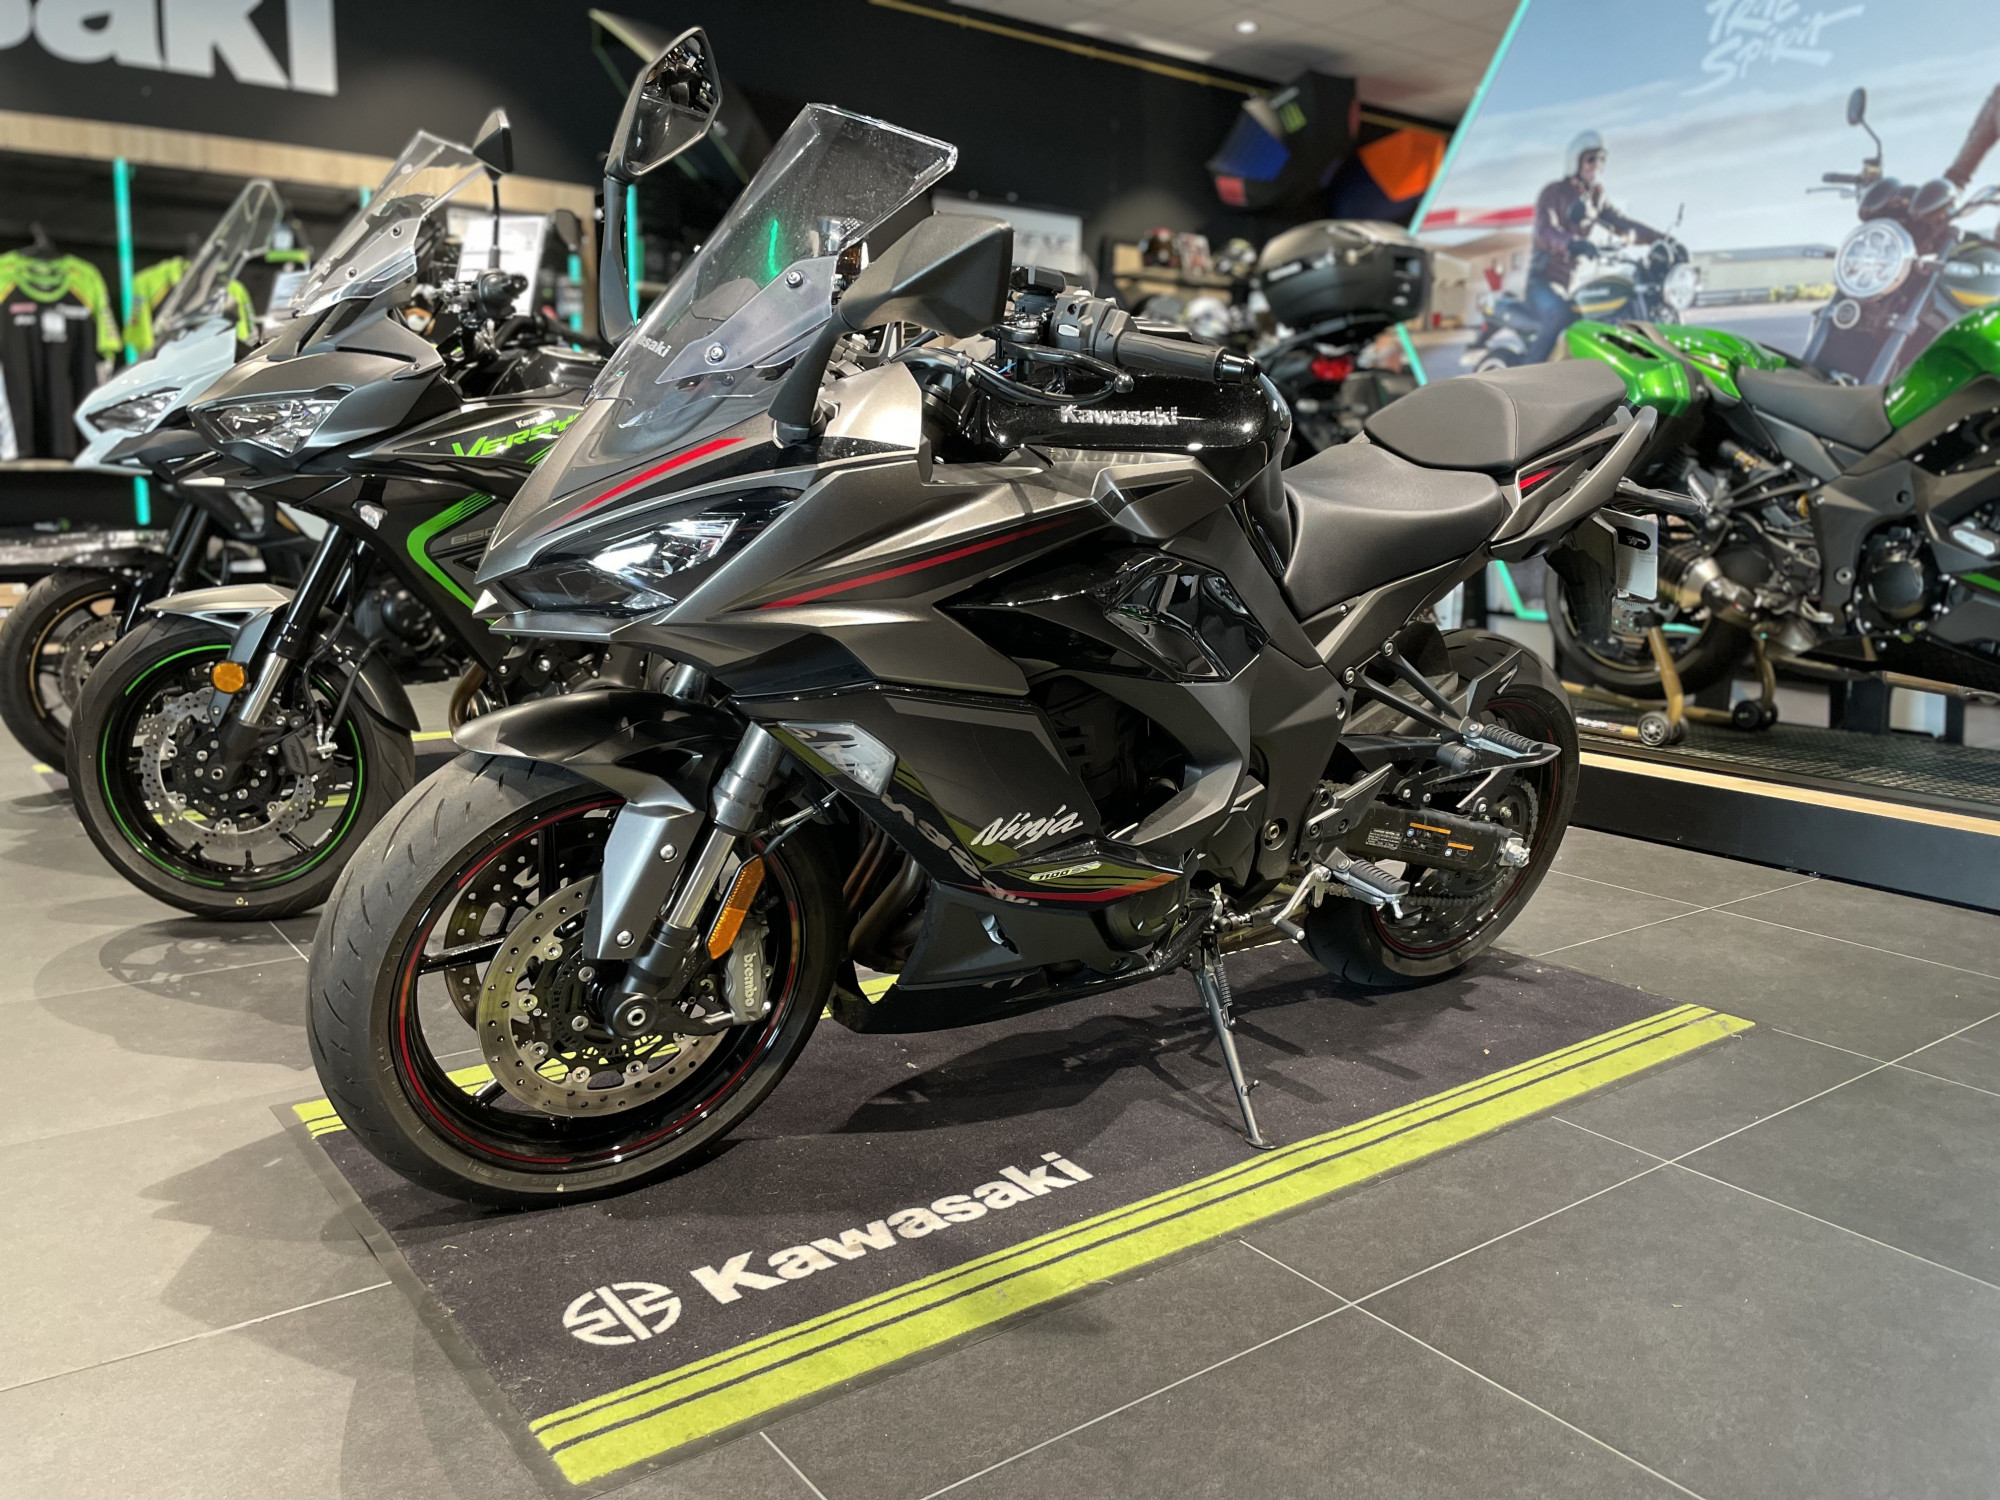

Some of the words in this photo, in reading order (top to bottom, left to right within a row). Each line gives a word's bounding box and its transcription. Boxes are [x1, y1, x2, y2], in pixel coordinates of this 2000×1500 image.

[451, 412, 581, 457] VERSY
[1059, 404, 1178, 426] Kawasaki
[970, 803, 1084, 850] Ninja
[743, 952, 758, 1007] brembo
[690, 1151, 1094, 1304] Kawasaki
